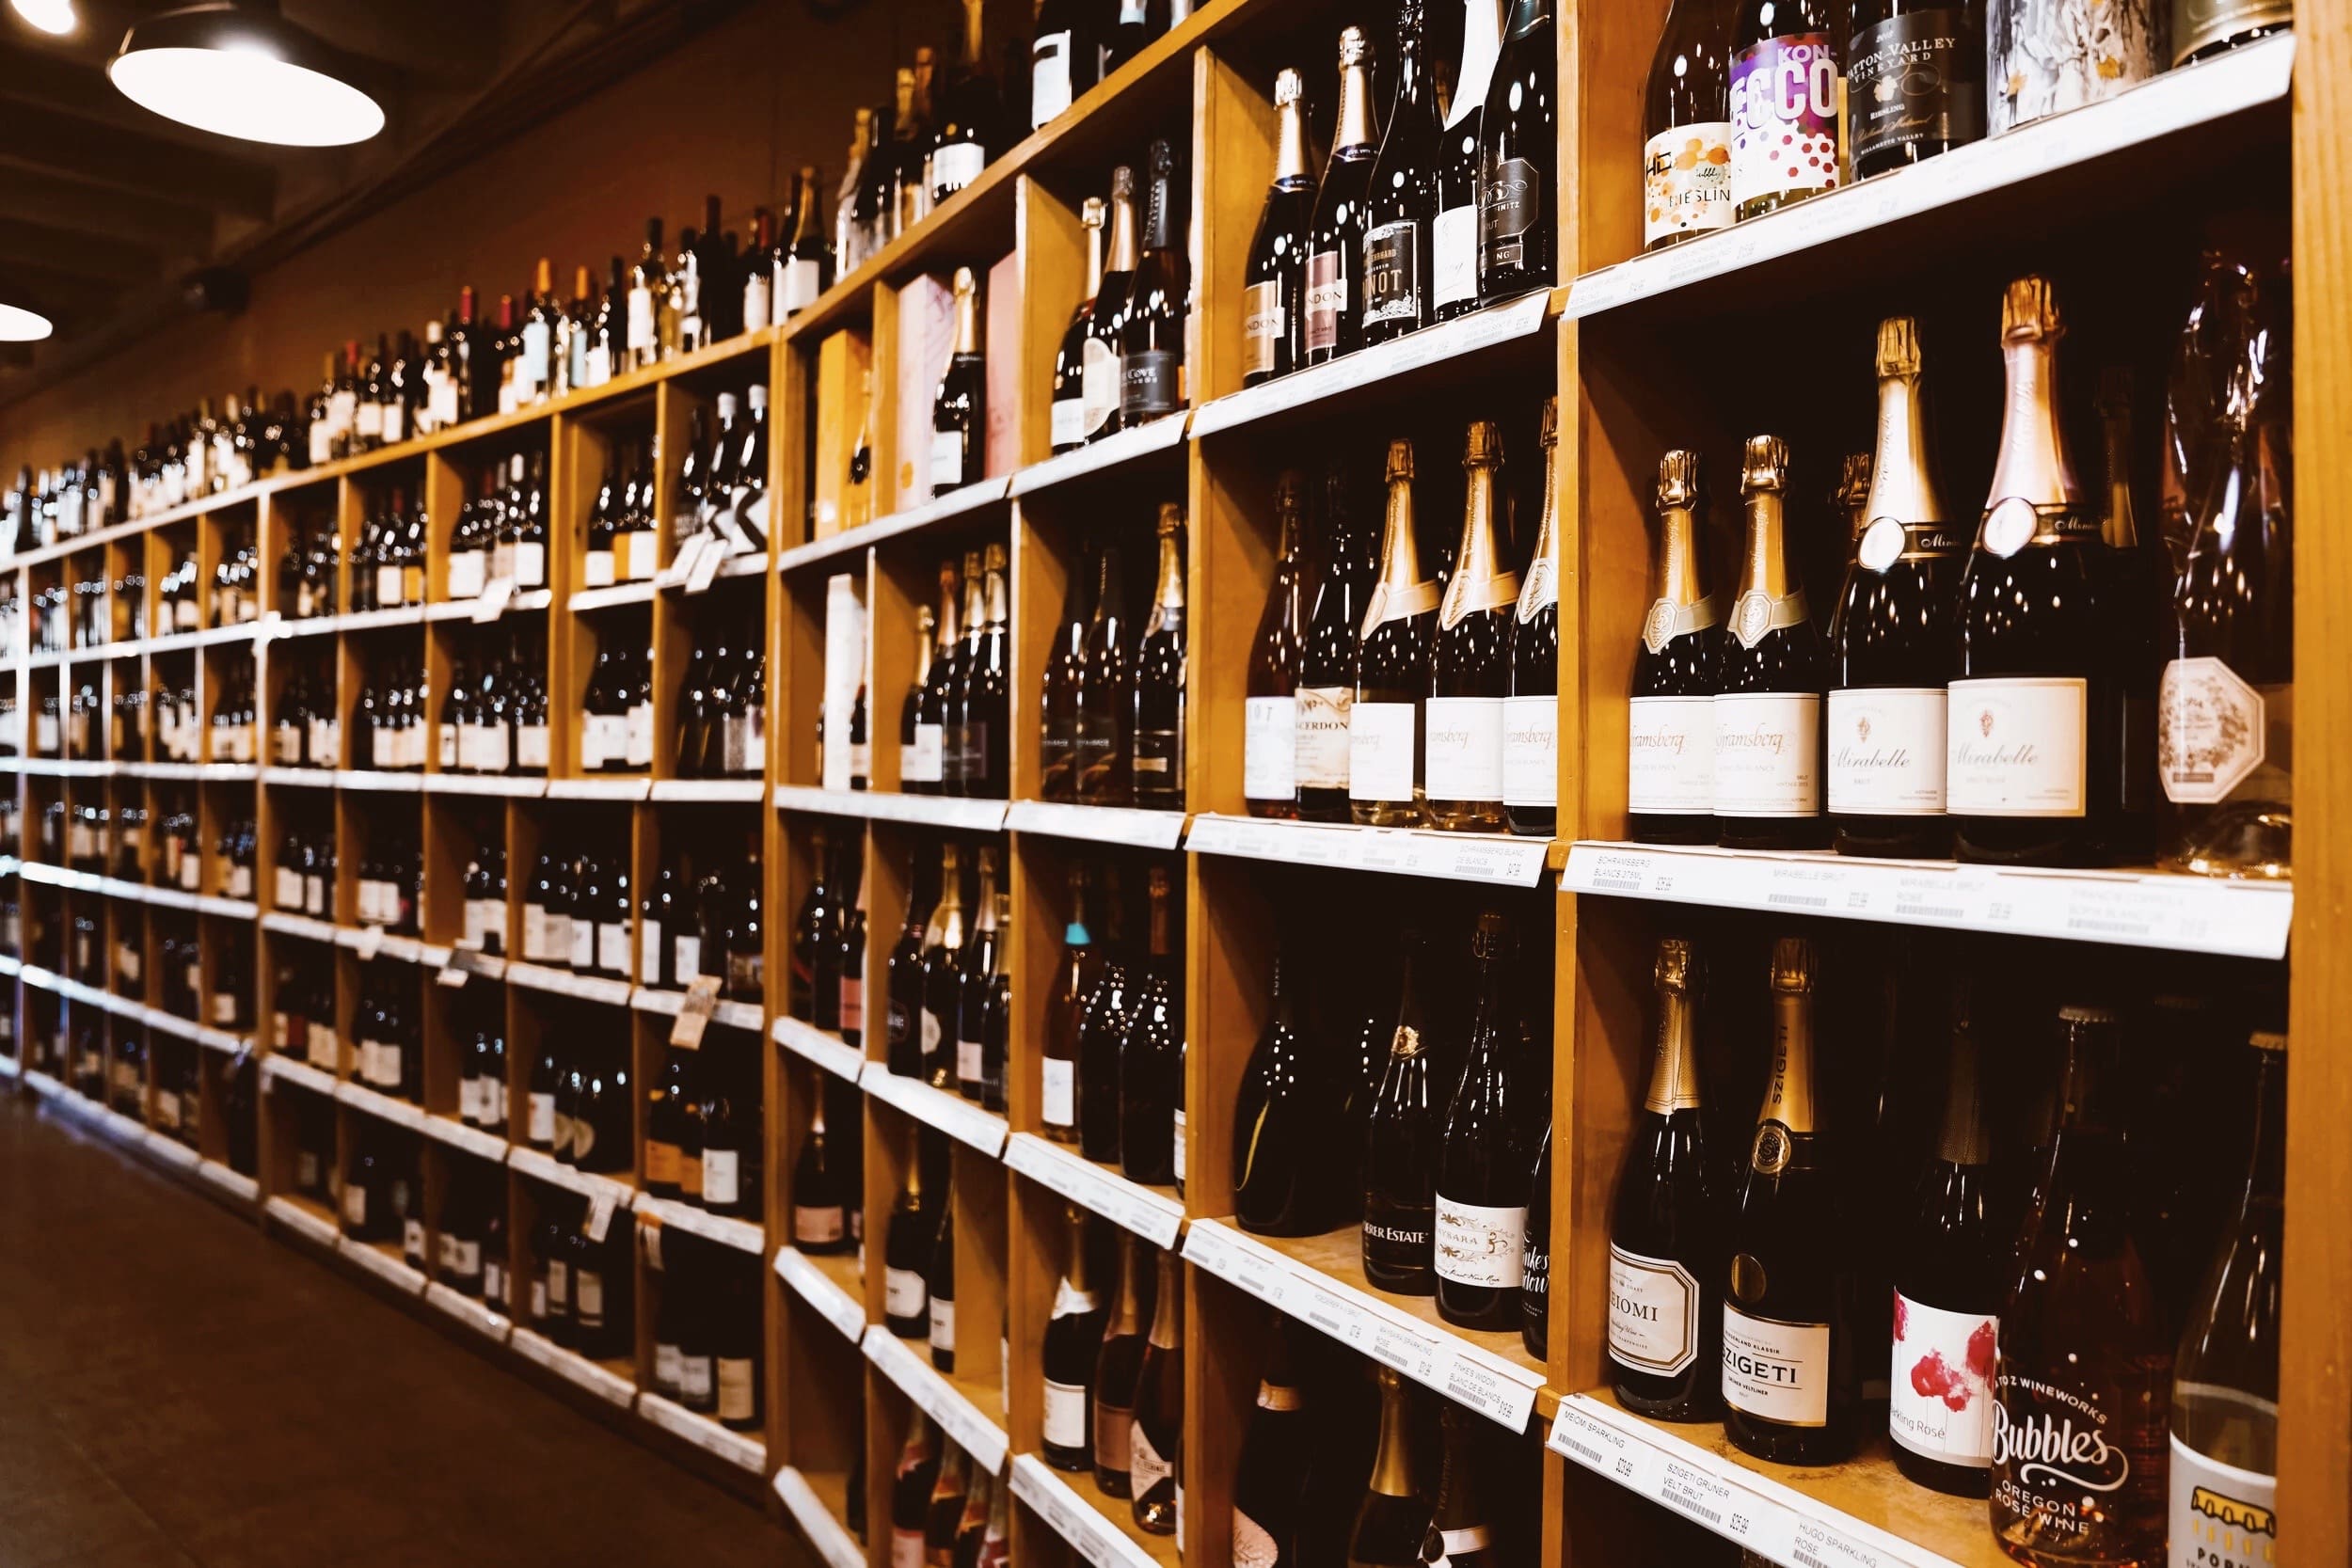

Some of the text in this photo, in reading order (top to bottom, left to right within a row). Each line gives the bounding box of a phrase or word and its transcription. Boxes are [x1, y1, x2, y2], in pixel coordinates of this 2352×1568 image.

[1887, 38, 1956, 56] VALLEY
[1853, 52, 1931, 83] VINEYARD
[1669, 189, 1731, 207] RIESLIN
[1831, 747, 1911, 768] Mirabelle
[1952, 741, 2039, 767] Mirabelle
[1597, 856, 1651, 868] SCHRAMSBERG
[1772, 1025, 1788, 1104] SZIGETI
[1386, 1227, 1425, 1243] ESTATE
[1723, 1341, 1796, 1384] SZIGETI
[1449, 1371, 1469, 1388] BLANC
[1477, 1386, 1502, 1404] BLANCS
[1742, 1384, 1769, 1396] VELTLINER
[2010, 1374, 2018, 1385] Z
[2019, 1377, 2108, 1426] WINEWORKS
[1587, 1422, 1626, 1449] SPARKLING
[1916, 1419, 1946, 1440] Rosé
[1992, 1399, 2128, 1469] Bubbles
[1663, 1477, 1704, 1501] VELT BRUT
[1666, 1463, 1730, 1500] SZIGETI GRUNER
[2001, 1478, 2076, 1517] OREGON
[1994, 1489, 2090, 1535] ROSÉ WINE
[1794, 1536, 1820, 1557] ROSE
[1798, 1522, 1878, 1568] HUGO SPARKLING
